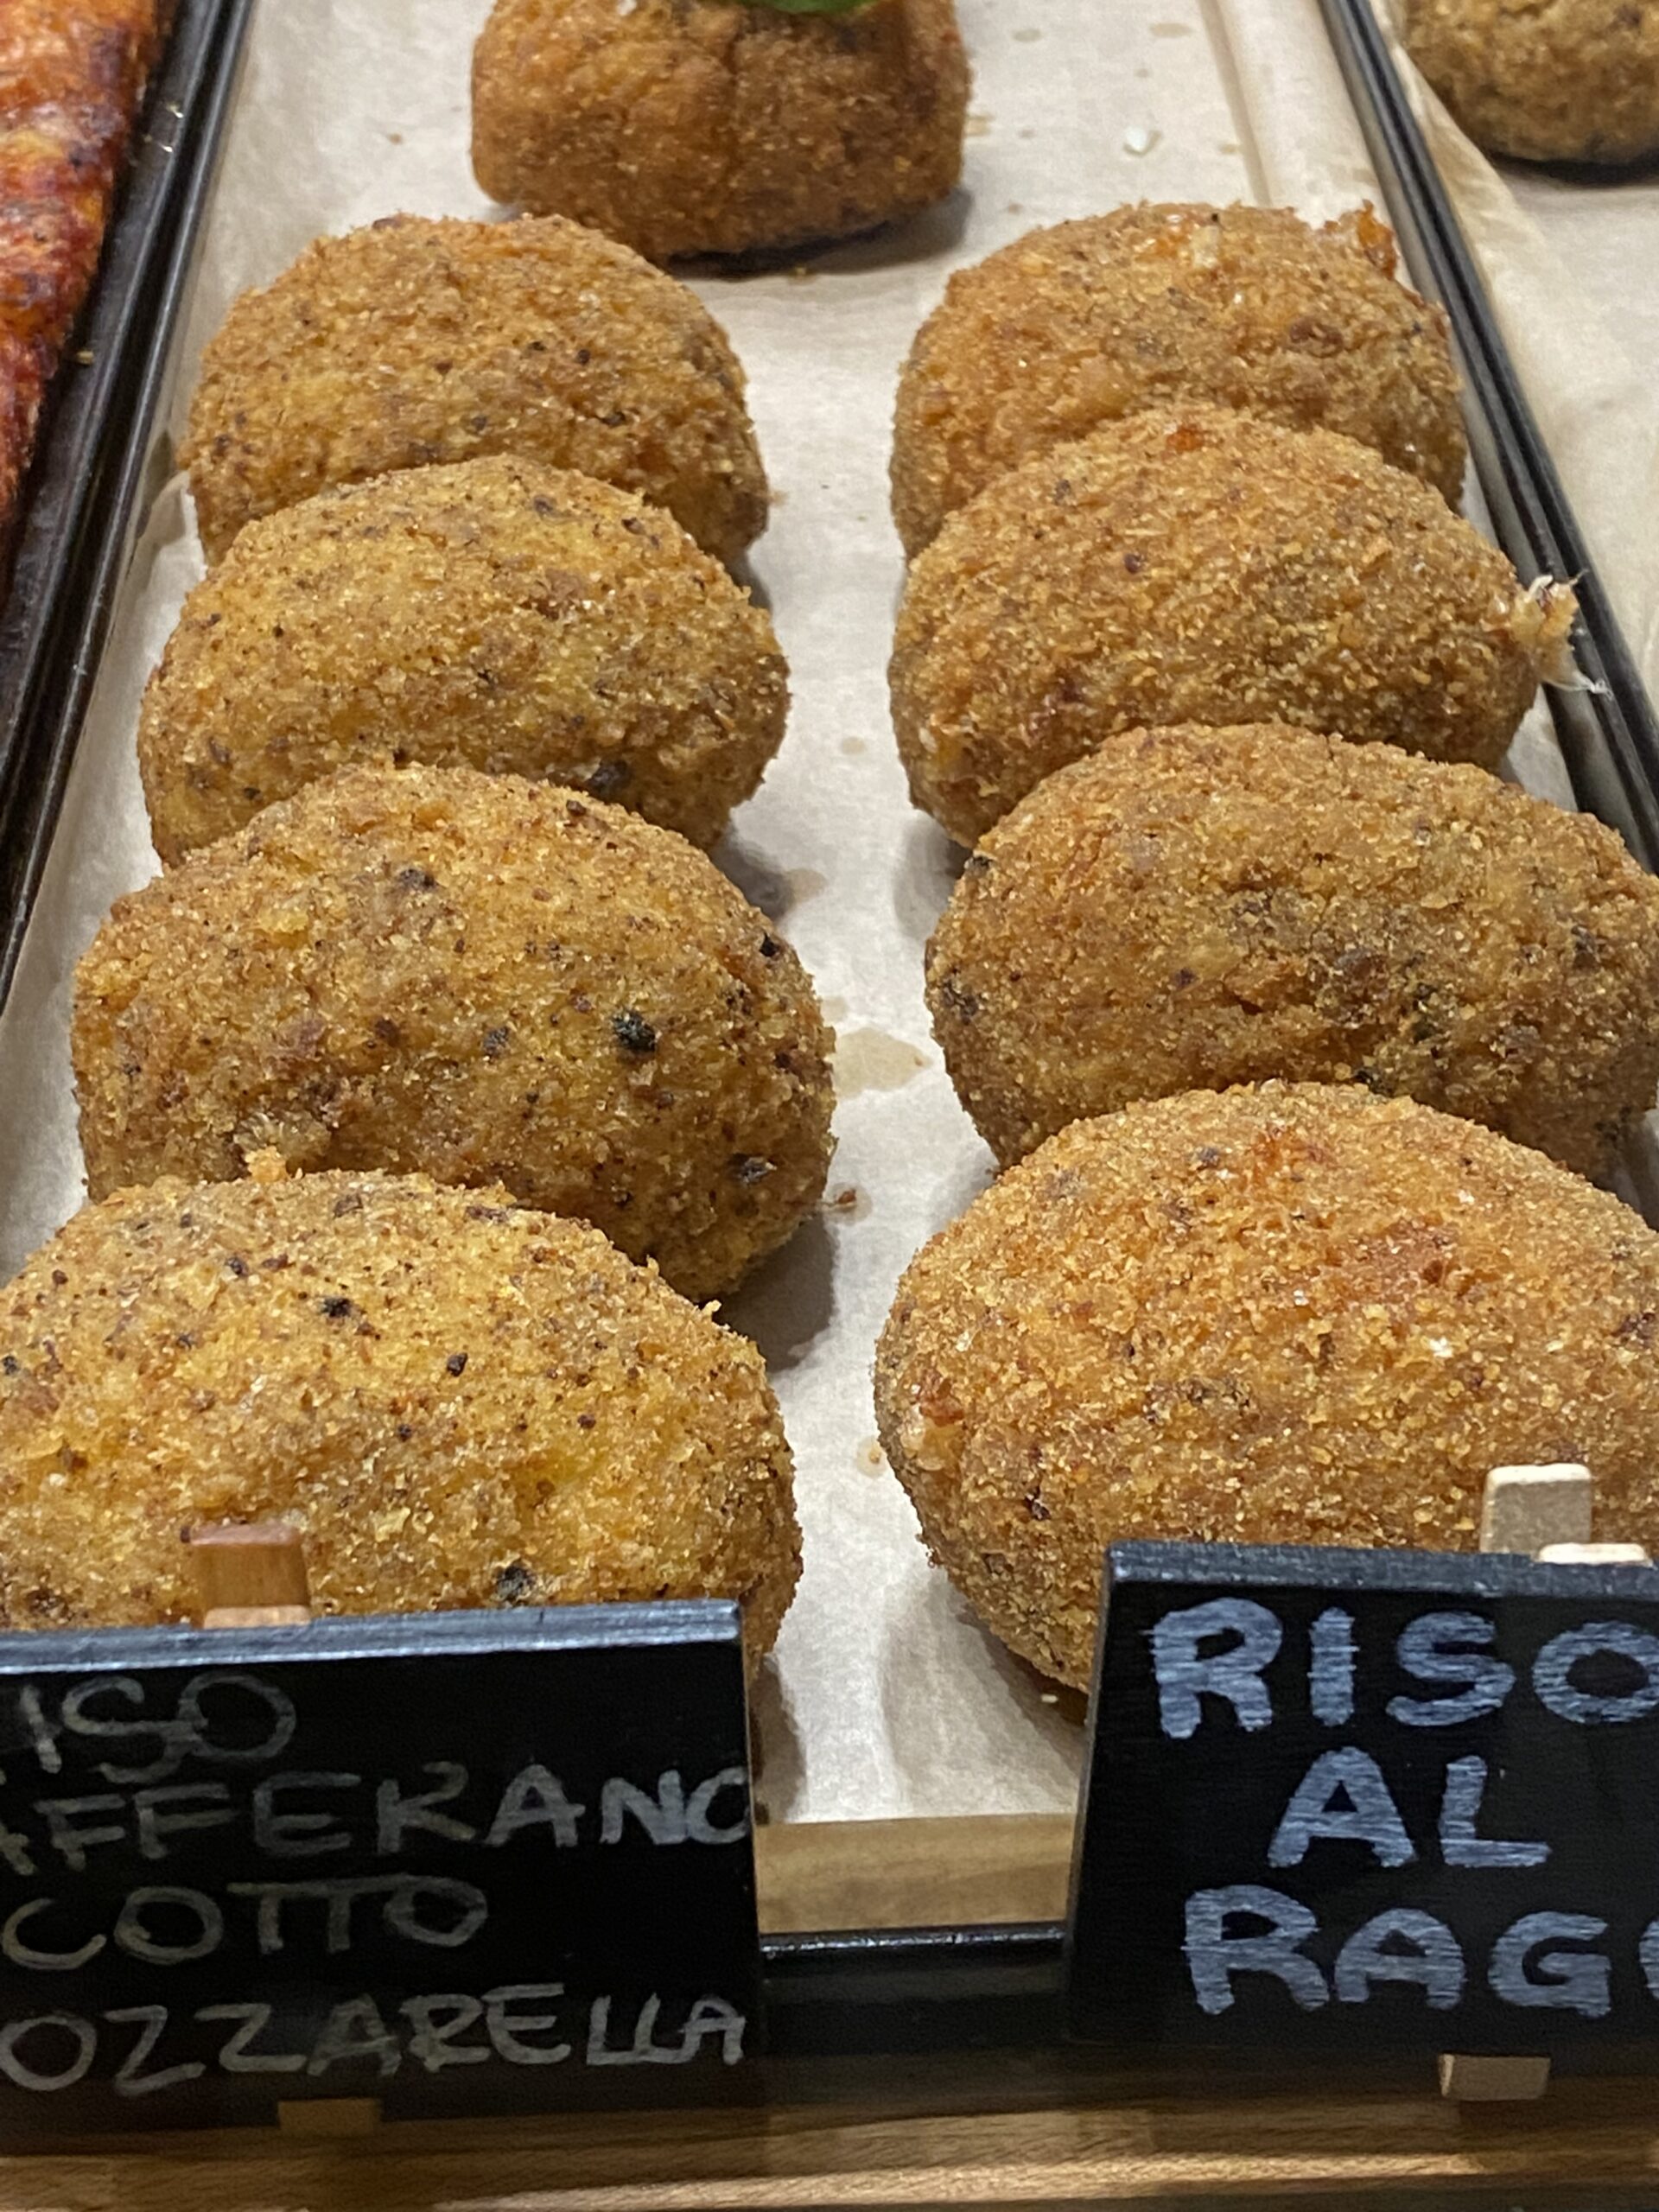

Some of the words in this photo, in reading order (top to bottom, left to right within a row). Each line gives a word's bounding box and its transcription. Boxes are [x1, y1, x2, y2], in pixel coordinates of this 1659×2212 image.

[19, 1671, 296, 1784] ISO
[1150, 1597, 1659, 1740] RISO
[1267, 1745, 1552, 1869] AL
[2, 1875, 489, 1971] COTTO
